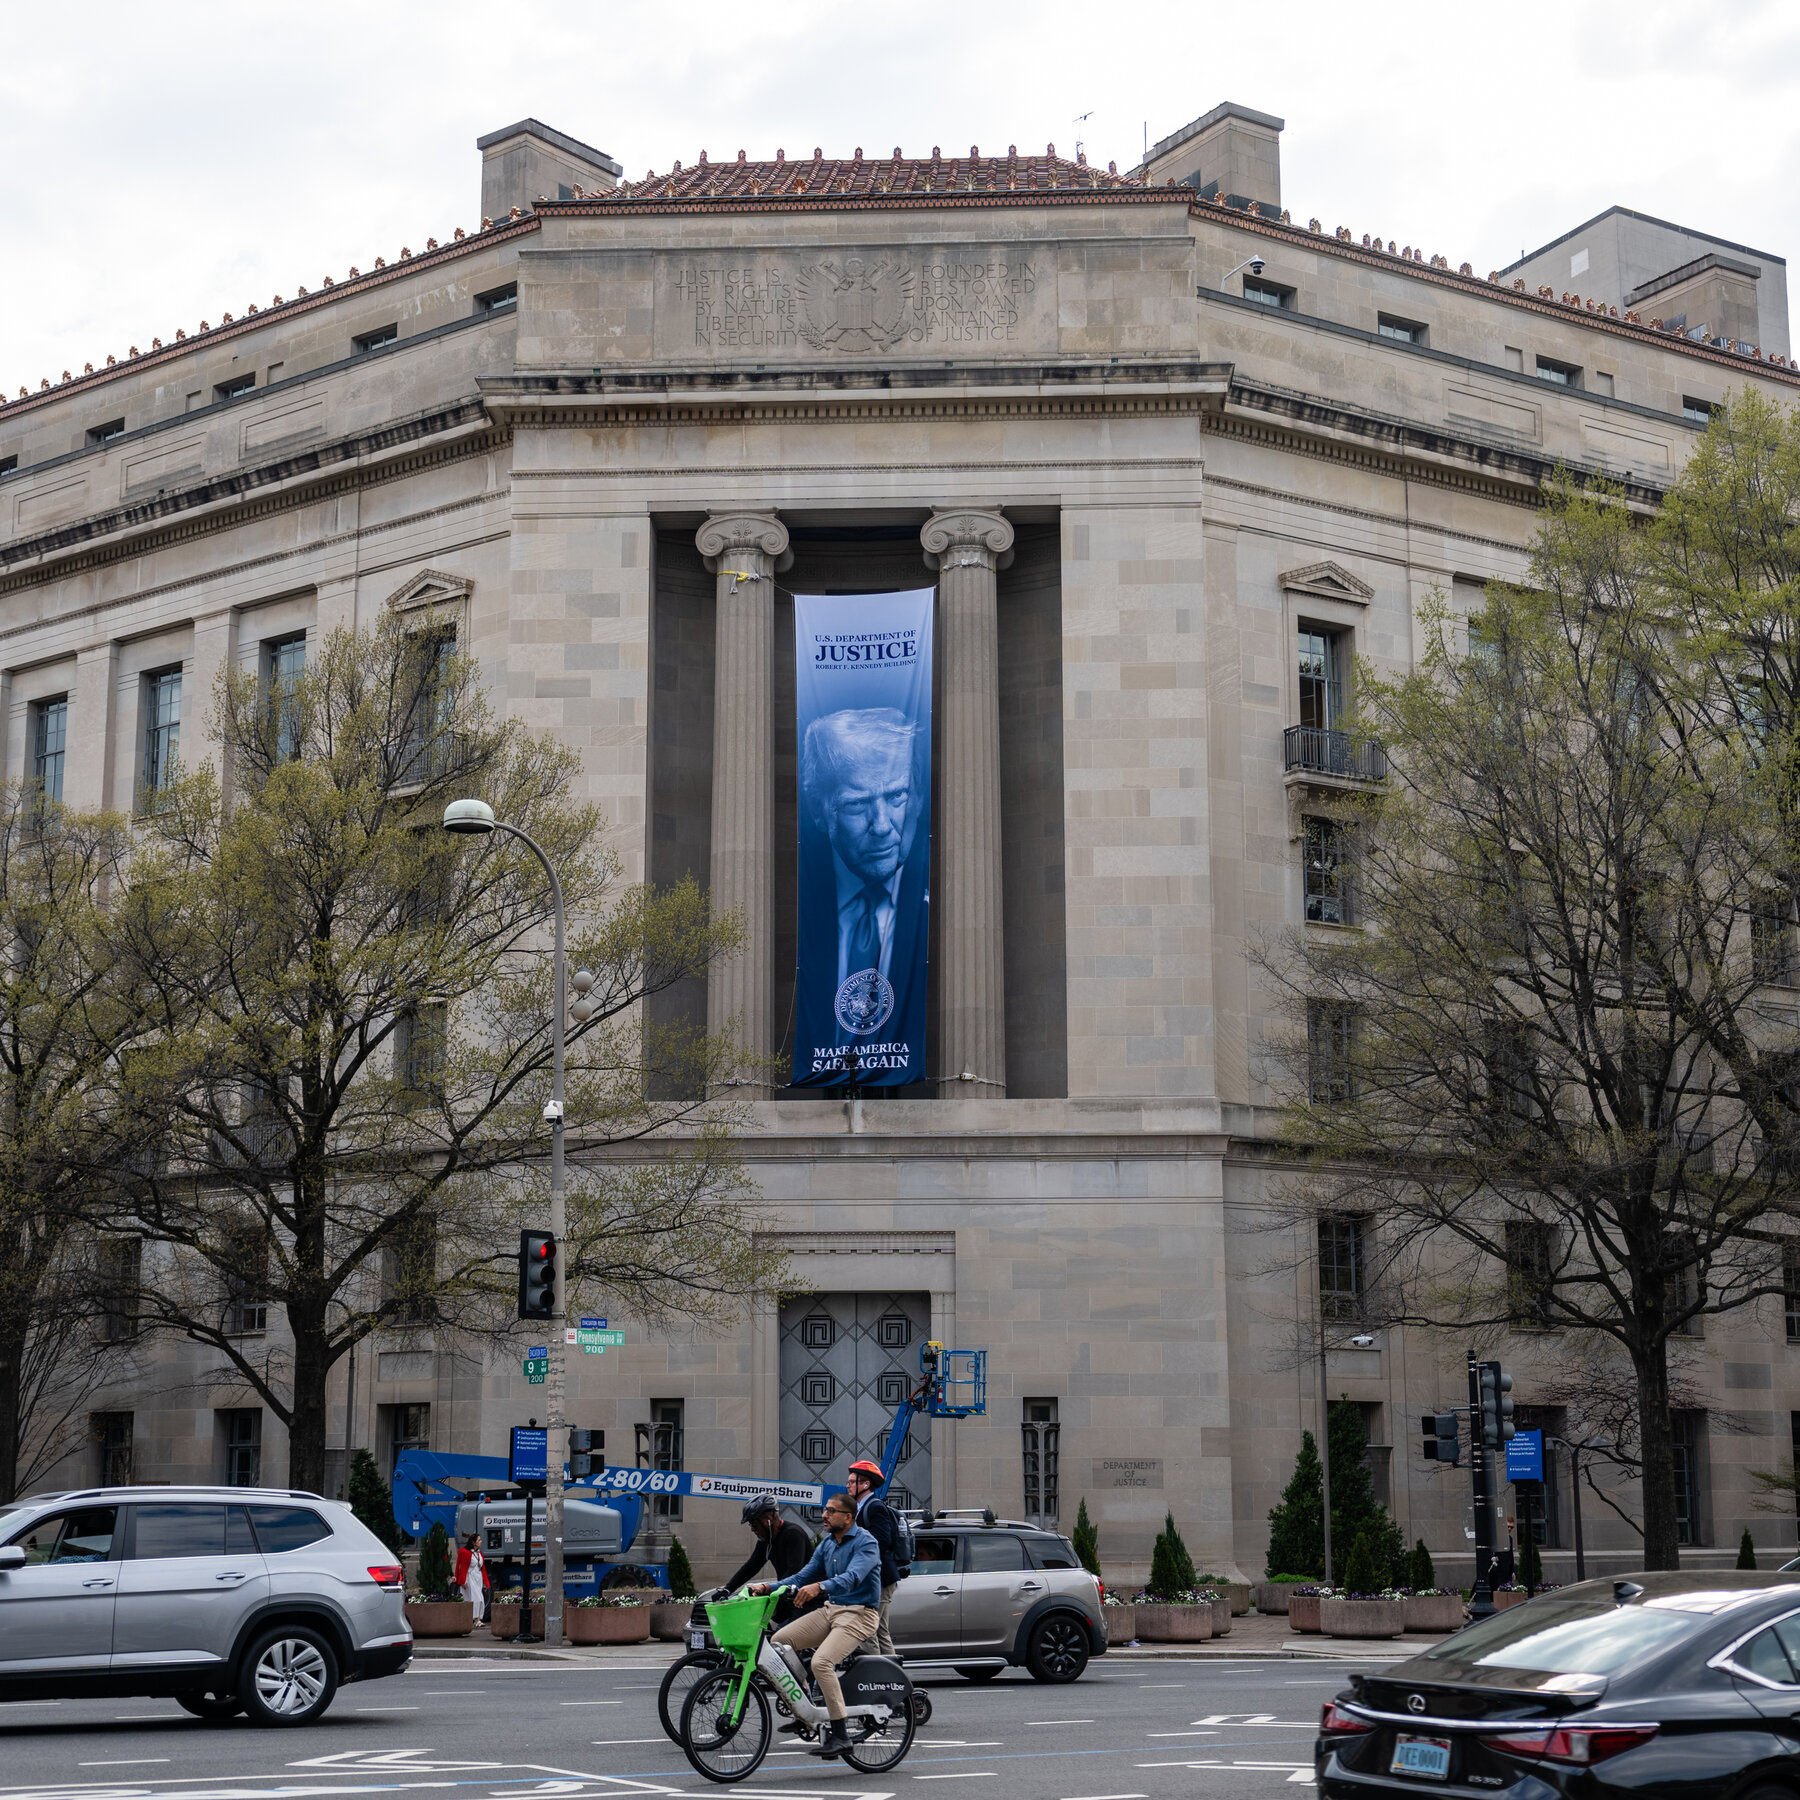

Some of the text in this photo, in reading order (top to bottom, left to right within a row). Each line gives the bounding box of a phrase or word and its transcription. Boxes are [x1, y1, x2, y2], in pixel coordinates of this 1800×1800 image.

[674, 268, 780, 285] JUSTICE IS
[922, 263, 1036, 279] FOUNDED IN
[675, 284, 791, 300] THE RIGHTS
[921, 279, 1035, 295] BESTOWED
[696, 300, 798, 315] BY NATURE
[912, 295, 1019, 310] UPON MAN.
[695, 315, 795, 331] LIBERTY IS
[913, 310, 1018, 326] MAINTAINED
[695, 331, 801, 346] IN SECURITY
[909, 328, 933, 342] OF
[835, 632, 901, 642] DEPARTMENT
[903, 630, 916, 638] OF
[815, 640, 917, 662] JUSTICE
[884, 659, 917, 668] BUILDING
[813, 1043, 910, 1058] MAKE AMERICA
[855, 1055, 910, 1070] AGAIN
[578, 1330, 615, 1345] Pennsylvania
[585, 1345, 604, 1354] 900
[528, 1361, 534, 1374] 9
[530, 1375, 544, 1383] 200
[1103, 1461, 1156, 1470] DEPARTMENT
[592, 1469, 679, 1492] Z-80/60
[1124, 1470, 1135, 1478] OF
[713, 1481, 813, 1498] EquipmentShare
[1113, 1478, 1147, 1487] JUSTICE
[857, 1682, 869, 1691] On
[869, 1682, 886, 1691] Lime
[890, 1682, 905, 1691] Uber
